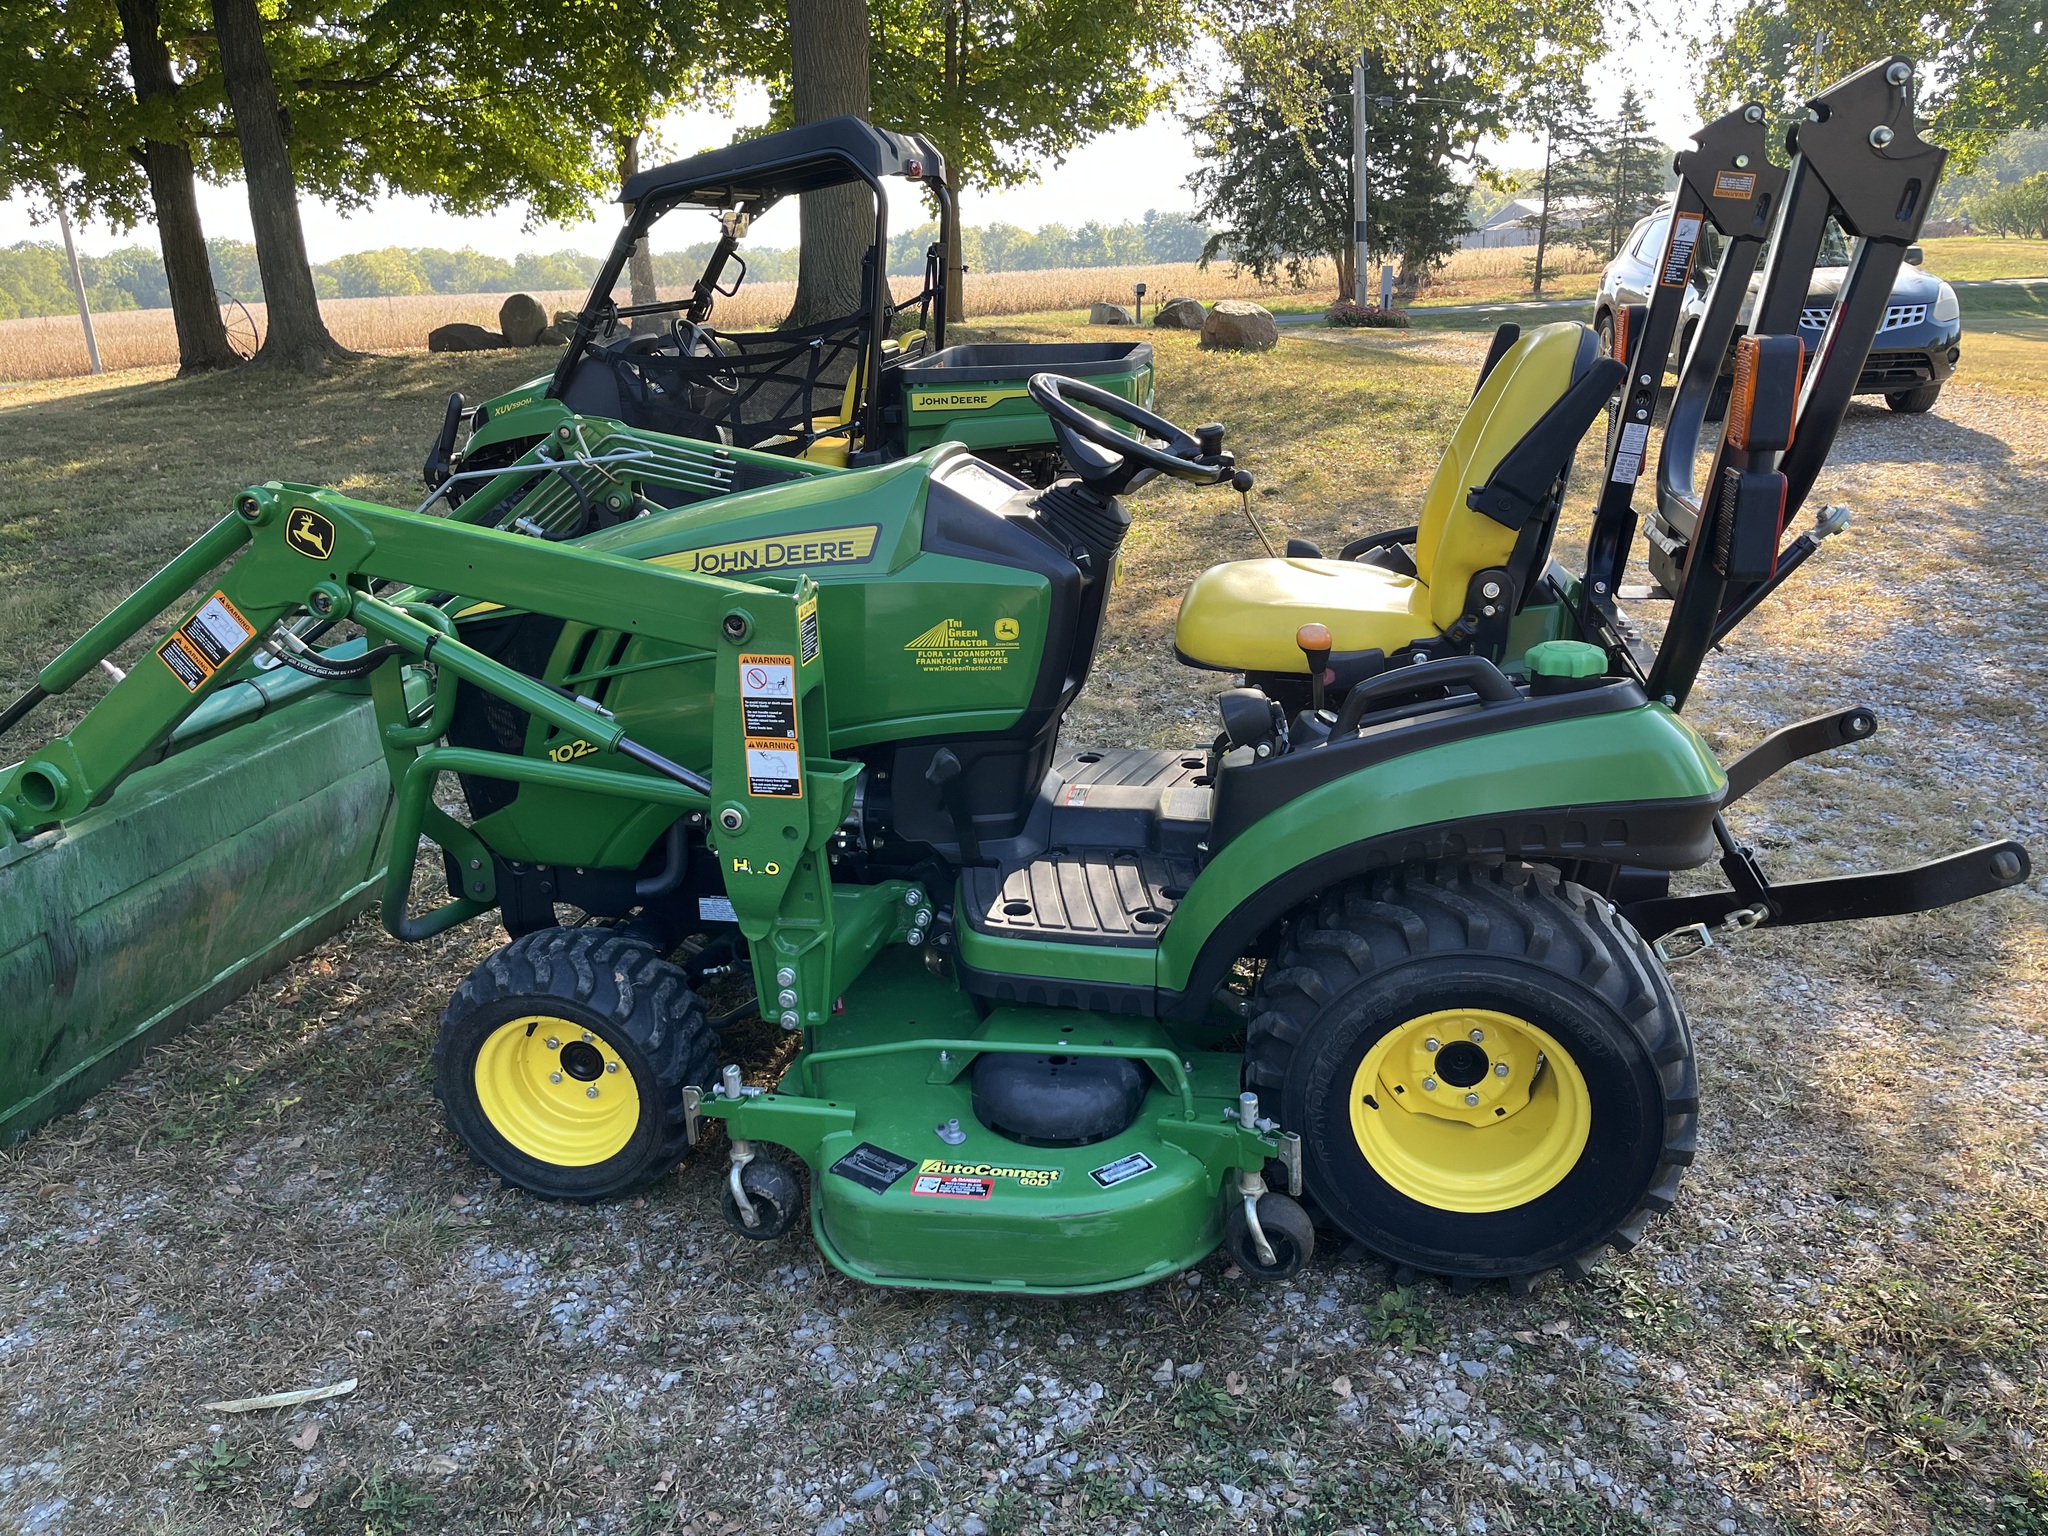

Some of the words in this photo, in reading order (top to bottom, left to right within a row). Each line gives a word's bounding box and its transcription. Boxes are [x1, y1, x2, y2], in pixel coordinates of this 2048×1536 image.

[1716, 190, 1744, 198] WARNING
[494, 397, 532, 416] XUV590M
[920, 397, 948, 405] JOHN
[951, 396, 987, 404] DEERE
[691, 549, 758, 572] JOHN
[765, 541, 854, 564] DEERE
[225, 602, 250, 631] WARNING
[948, 638, 988, 647] TRACTOR
[183, 644, 208, 672] WARNING
[756, 741, 795, 749] WARNING
[922, 1161, 1060, 1180] AutoConnect
[1019, 1177, 1049, 1186] 60D
